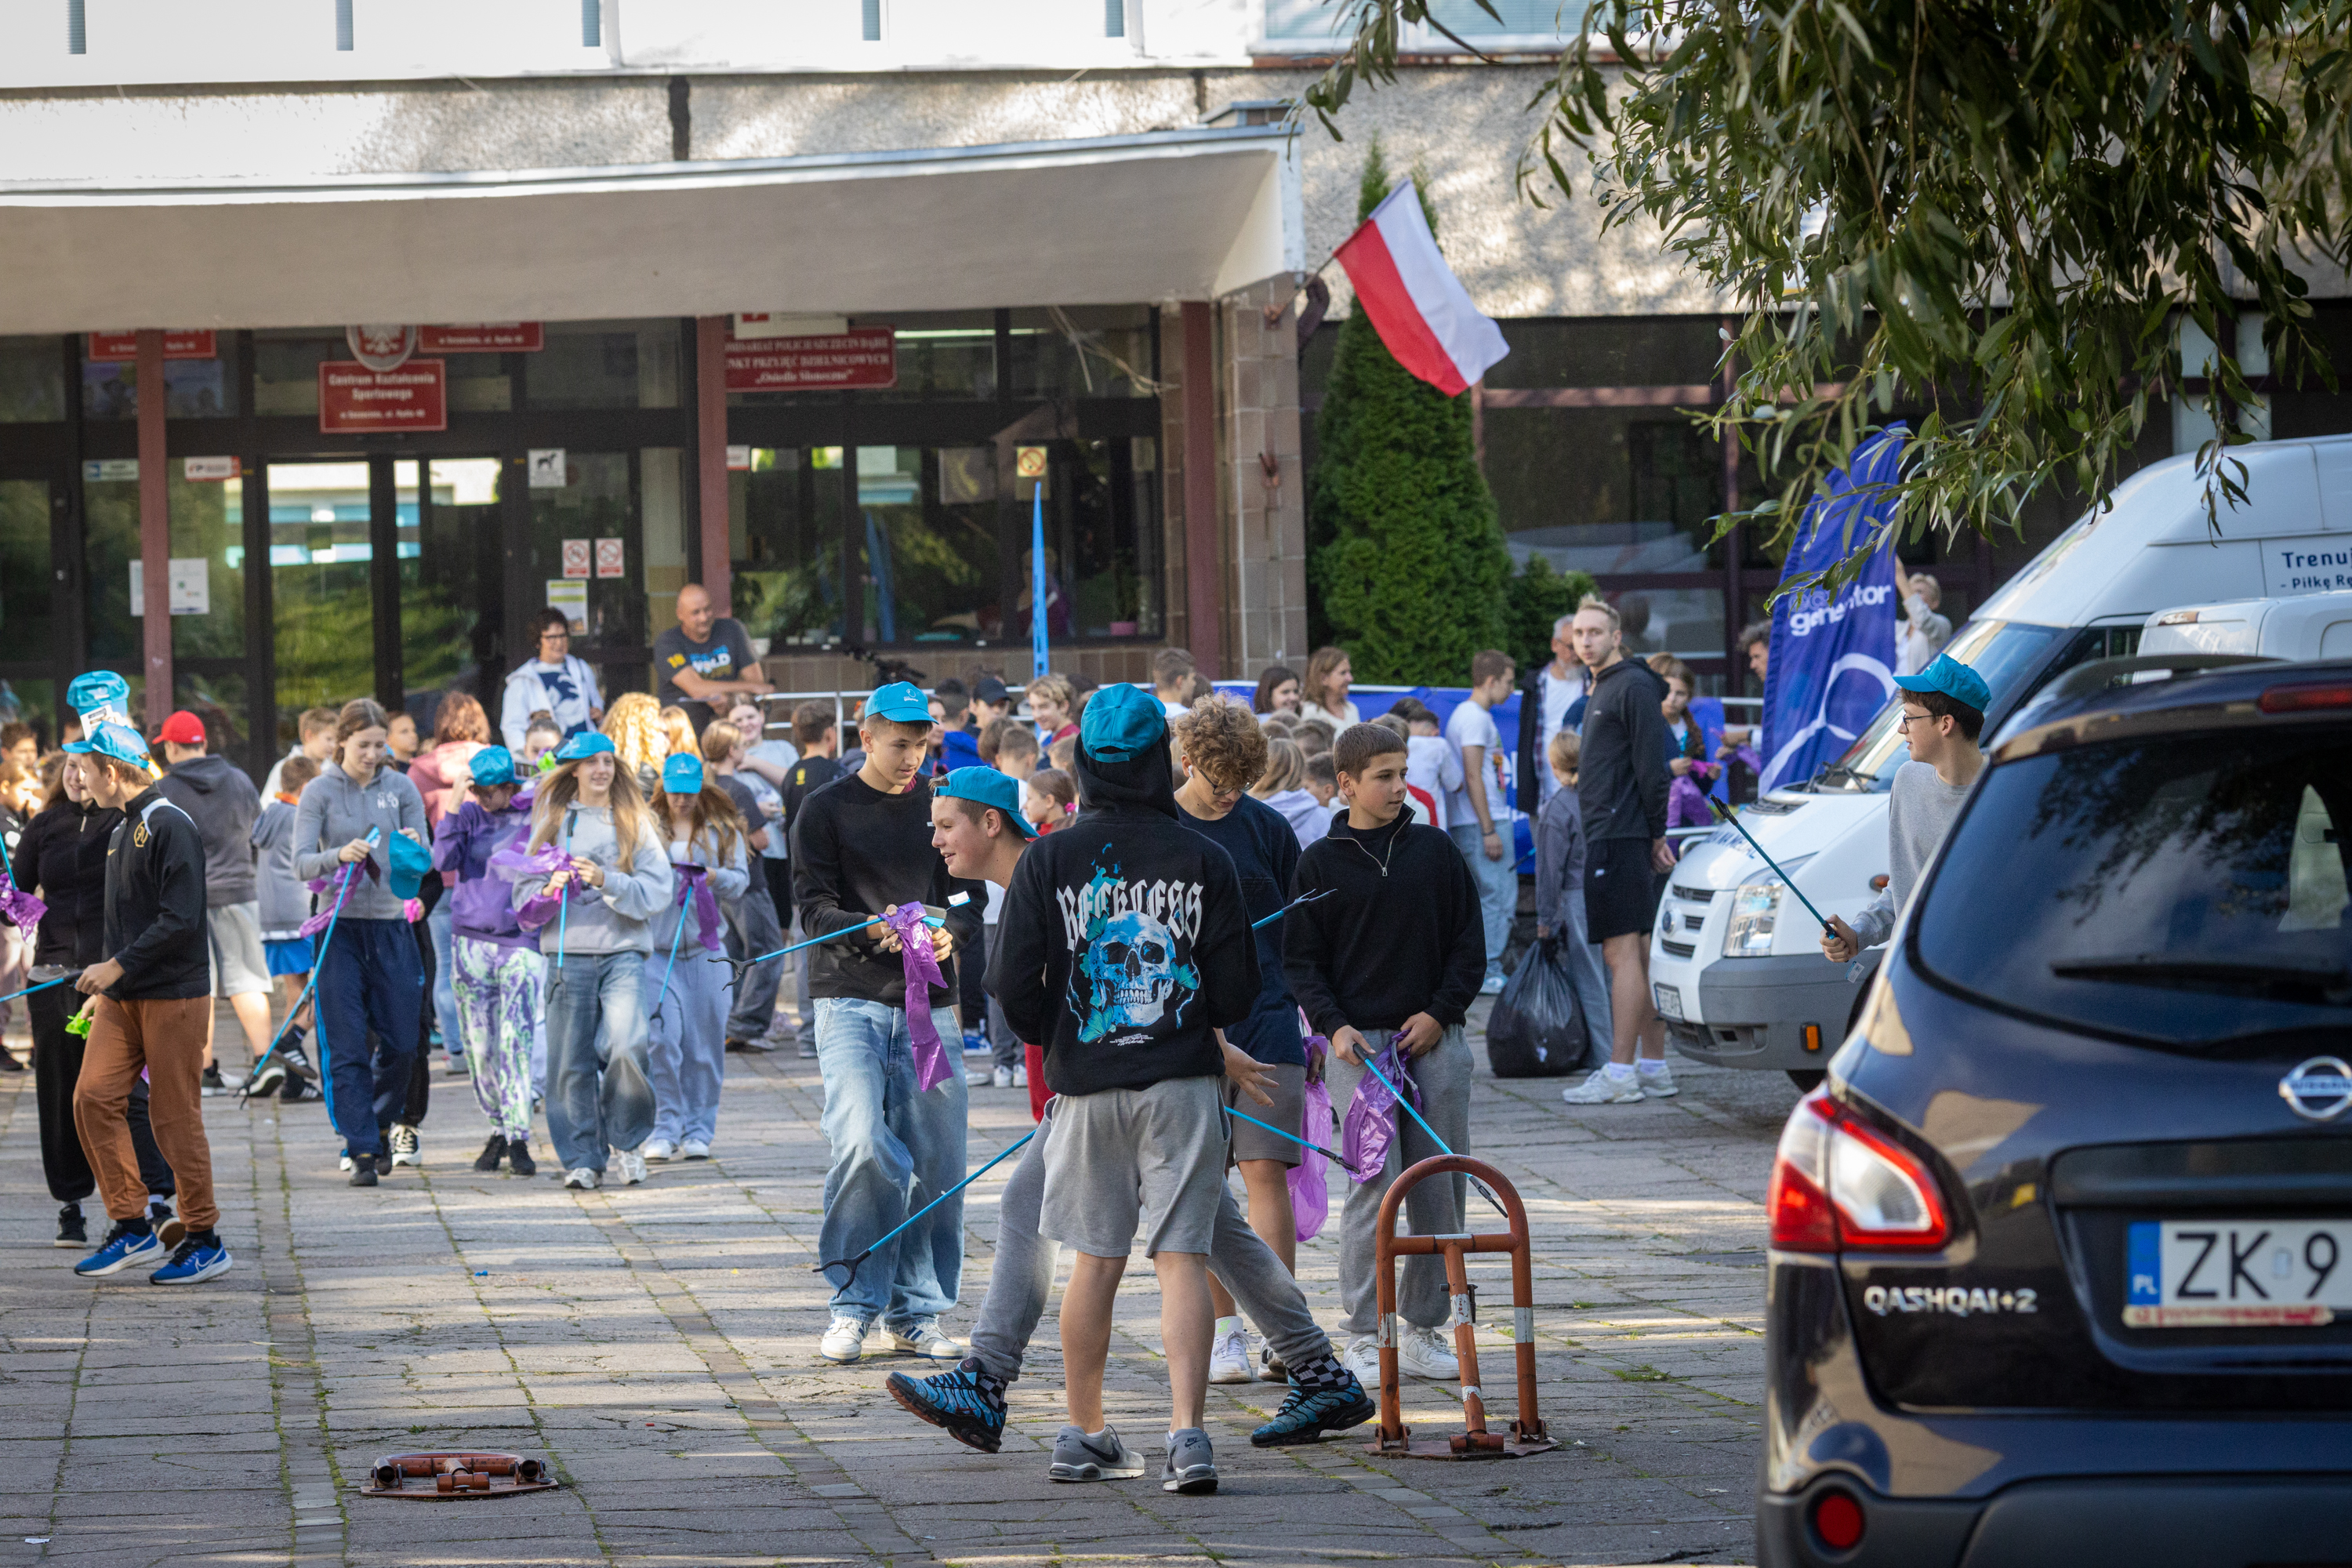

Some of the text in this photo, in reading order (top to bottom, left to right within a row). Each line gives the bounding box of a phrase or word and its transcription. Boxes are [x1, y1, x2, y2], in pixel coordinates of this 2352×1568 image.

[328, 374, 373, 386] Centrum
[352, 387, 414, 401] Sportowego
[2292, 575, 2331, 590] Piłkę
[2175, 1229, 2340, 1300] ZK 9
[2132, 1273, 2158, 1295] PL
